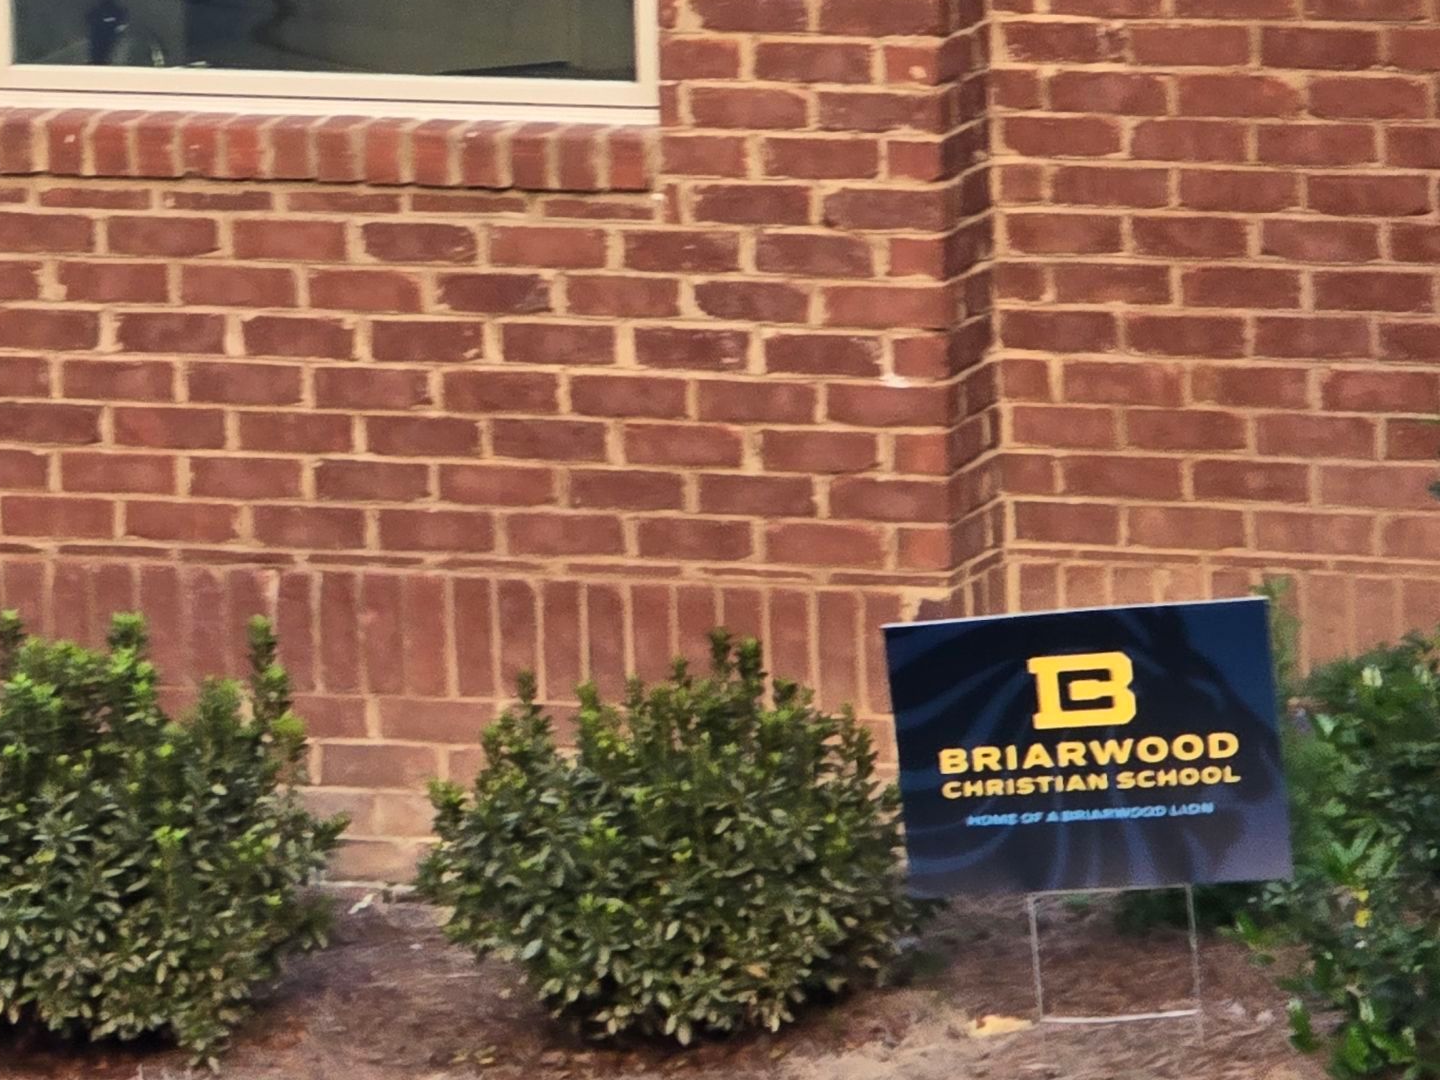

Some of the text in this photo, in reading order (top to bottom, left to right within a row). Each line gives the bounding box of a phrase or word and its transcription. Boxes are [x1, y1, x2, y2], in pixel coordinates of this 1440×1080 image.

[1027, 651, 1137, 730] B
[938, 732, 1240, 774] BRIARWOOD
[942, 765, 1242, 799] CHRISTIAN SCHOOL
[966, 812, 1019, 826] HOME
[1020, 811, 1044, 824] OF
[1045, 810, 1059, 822] A
[1061, 804, 1167, 822] BRIARWOOD
